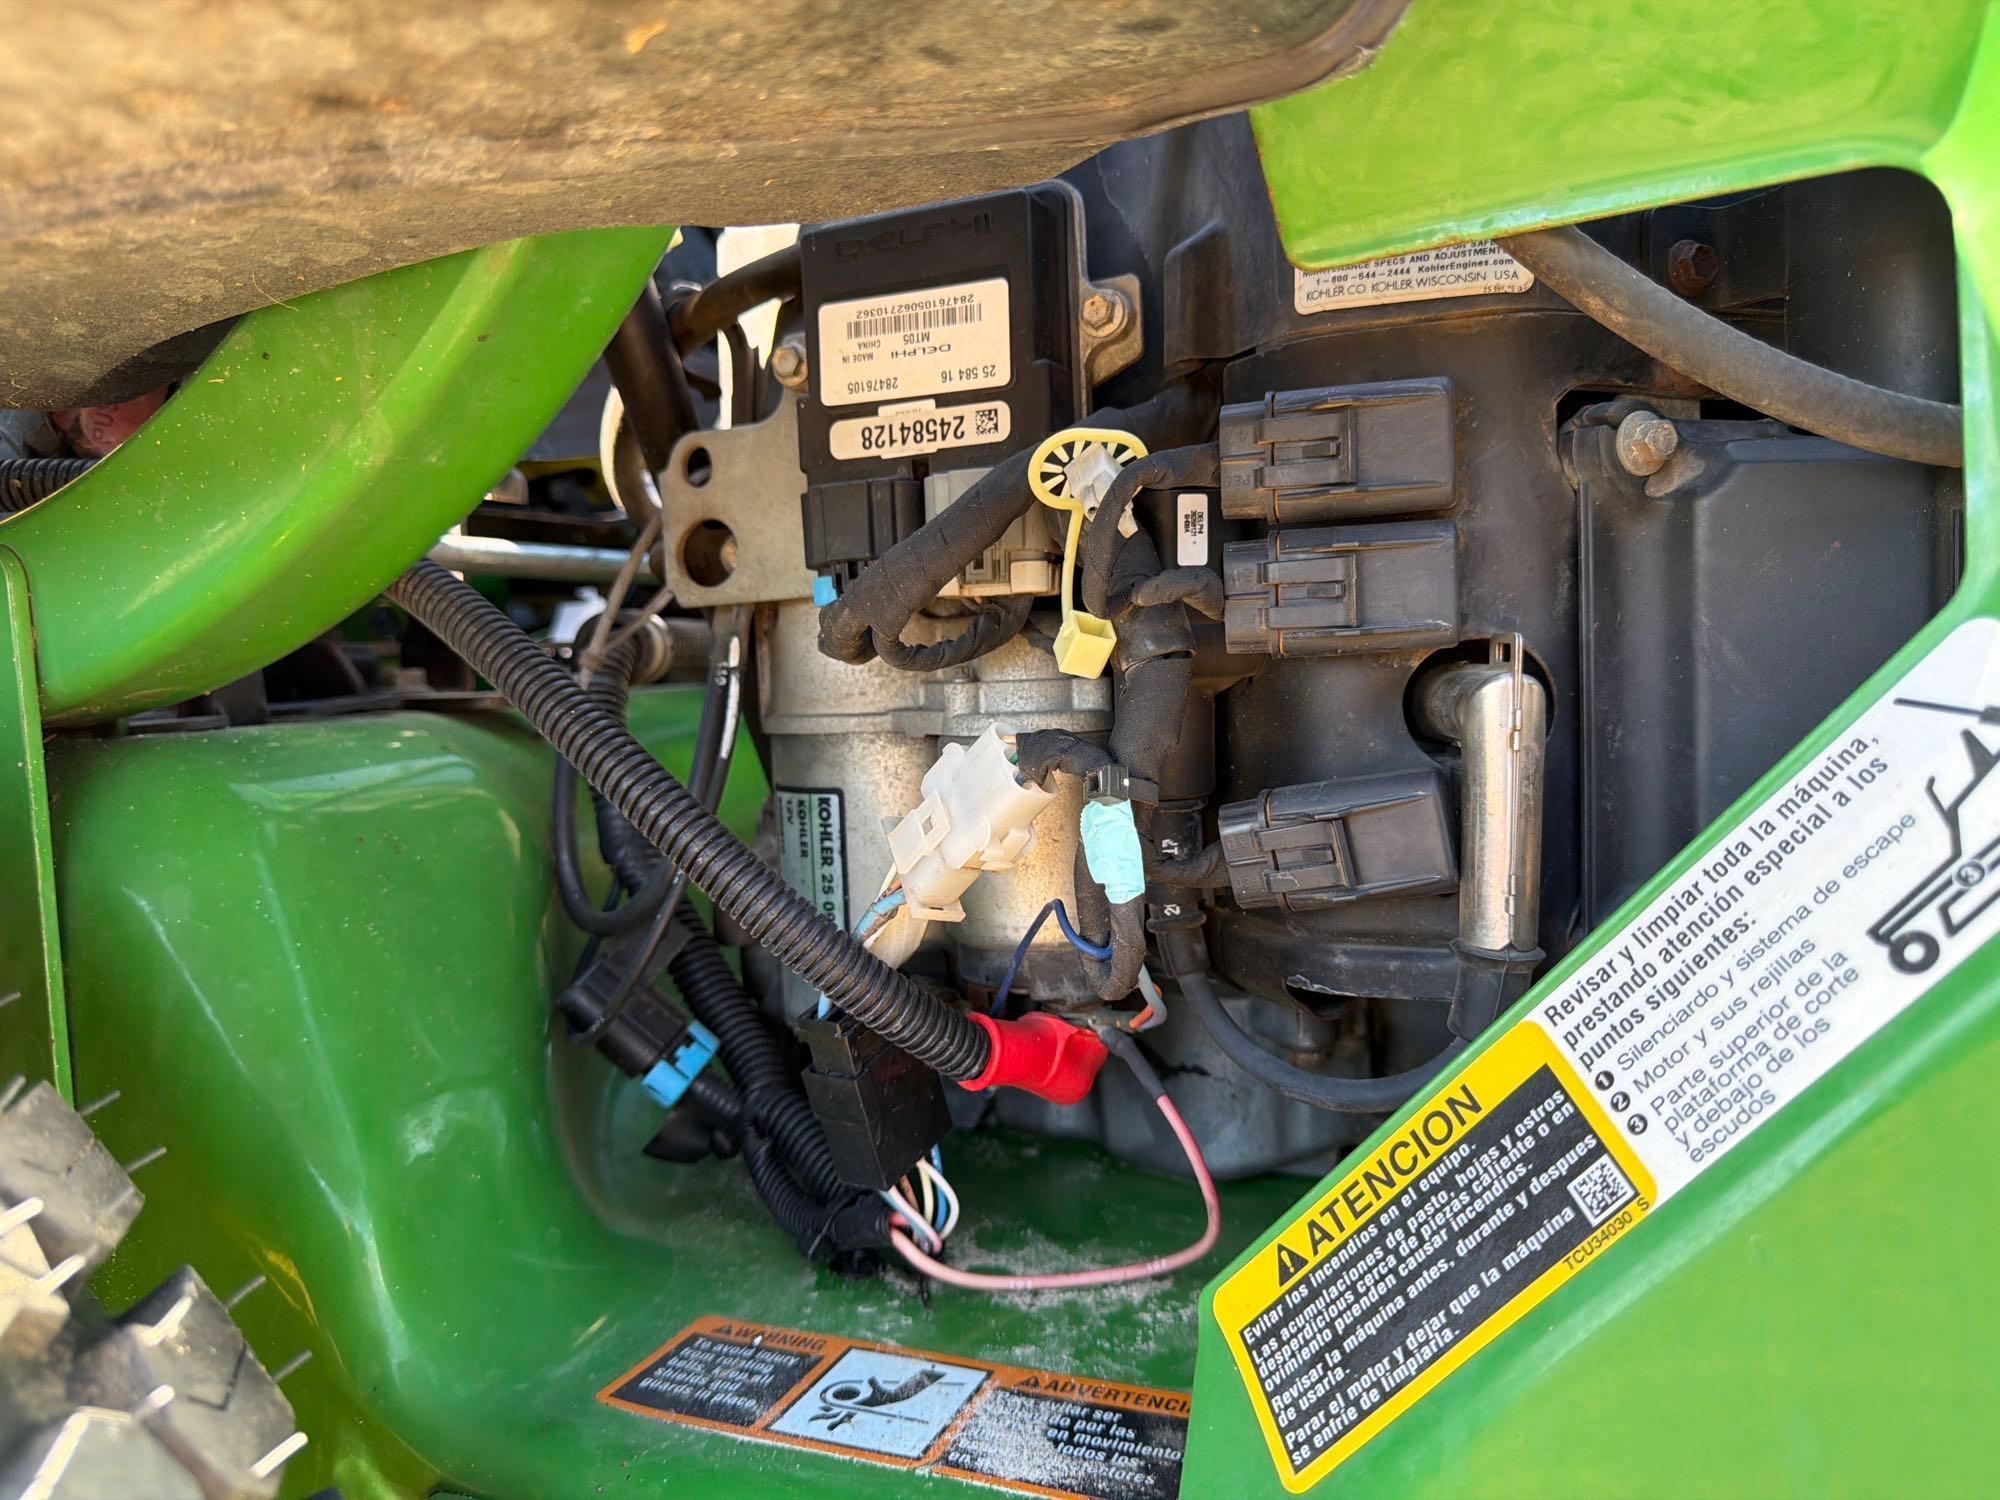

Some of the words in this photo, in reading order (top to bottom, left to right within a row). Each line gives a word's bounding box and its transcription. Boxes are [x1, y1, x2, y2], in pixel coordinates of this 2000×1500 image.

[1374, 257, 1406, 268] SPECS
[1409, 254, 1430, 264] AND
[1434, 246, 1503, 261] ADJUSTMENT
[1418, 258, 1514, 274] KohlerEngines.com
[1306, 286, 1344, 302] KOHLER
[1415, 271, 1487, 288] WISCONSIN
[1494, 270, 1519, 281] USA
[856, 294, 973, 319] 28476105062710362
[857, 339, 881, 350] CHINA
[890, 343, 951, 358] DELPHI
[903, 331, 930, 345] MT05
[852, 352, 873, 362] MADE
[958, 366, 978, 380] 584
[982, 364, 996, 378] 25
[847, 377, 898, 394] 28476105
[940, 370, 953, 383] 16
[861, 415, 964, 449] 24584128
[797, 799, 808, 858] KOHLER
[821, 874, 834, 895] 25
[1544, 959, 1617, 1026] Revisar
[1618, 945, 1635, 966] y
[1631, 881, 1703, 948] limpiar
[1702, 841, 1752, 883] toda
[1748, 819, 1776, 841] la
[1776, 738, 1878, 819] máquina,
[1563, 962, 1657, 1051] prestando
[1658, 885, 1743, 963] atención
[1744, 804, 1832, 885] especial
[1832, 791, 1851, 807] a
[1846, 758, 1888, 790] los
[1617, 984, 1718, 1070] Silenciardo
[1720, 969, 1734, 988] y
[1736, 905, 1812, 971] sistema
[1813, 880, 1840, 904] de
[1842, 814, 1915, 878] escape
[1579, 1008, 1644, 1072] puntos
[1646, 912, 1755, 1010] siguientes:
[1632, 1042, 1689, 1093] Motor
[1692, 1028, 1707, 1048] y
[1710, 996, 1747, 1030] sus
[1749, 939, 1815, 996] rejillas
[1650, 1069, 1706, 1116] Parte
[1709, 996, 1789, 1069] superior
[1794, 972, 1823, 997] de
[1821, 952, 1848, 971] la
[1664, 1041, 1771, 1134] plataforma
[1773, 1015, 1801, 1040] de
[1804, 968, 1858, 1014] corte
[1675, 1131, 1690, 1151] y
[1693, 1073, 1762, 1132] debajo
[1766, 1048, 1794, 1073] de
[1793, 1018, 1830, 1048] los
[1690, 1090, 1775, 1162] escudos
[1308, 1086, 1480, 1254] ATENCION
[1252, 1337, 1278, 1364] Las
[1280, 1247, 1383, 1340] acumulaciones
[1385, 1228, 1405, 1249] de
[1407, 1190, 1455, 1232] pasto,
[1455, 1146, 1499, 1187] hojas
[1500, 1134, 1512, 1151] y
[1514, 1090, 1564, 1136] ostros
[1259, 1291, 1354, 1377] desperdicious
[1356, 1254, 1396, 1293] cerca
[1398, 1235, 1418, 1256] de
[1420, 1191, 1470, 1240] piezas
[1472, 1136, 1535, 1193] caliente
[1537, 1123, 1549, 1136] o
[1552, 1102, 1574, 1124] en
[1563, 1211, 1632, 1269] TCU34030
[1636, 1196, 1650, 1211] S
[1243, 1304, 1283, 1344] Evitar
[1284, 1284, 1308, 1308] los
[1309, 1224, 1377, 1286] incendios
[1379, 1205, 1399, 1226] en
[1401, 1186, 1417, 1207] el
[1419, 1144, 1475, 1191] equipo.
[1264, 1329, 1332, 1391] ovimiento
[1334, 1274, 1396, 1334] puenden
[1398, 1228, 1447, 1276] causar
[1449, 1163, 1532, 1231] incendios.
[1271, 1363, 1323, 1413] Revisar
[1324, 1349, 1341, 1367] la
[1343, 1295, 1405, 1352] máquina
[1406, 1259, 1454, 1298] antes,
[1456, 1203, 1514, 1256] durante
[1515, 1191, 1528, 1209] y
[1529, 1134, 1596, 1194] despues
[1285, 1410, 1325, 1449] Parar
[1328, 1392, 1345, 1414] el
[1346, 1357, 1390, 1399] motor
[1392, 1346, 1404, 1364] y
[1406, 1310, 1446, 1352] dejar
[1449, 1284, 1480, 1314] que
[1480, 1267, 1500, 1287] la
[1502, 1207, 1574, 1270] máquina
[680, 1347, 715, 1362] from
[694, 1337, 712, 1350] To
[713, 1343, 757, 1358] avoid
[756, 1349, 800, 1368] injury
[639, 1377, 694, 1395] guards
[694, 1387, 712, 1400] in
[653, 1366, 710, 1387] shields
[710, 1379, 744, 1393] and
[1278, 1406, 1296, 1427] de
[1298, 1367, 1349, 1410] usarla.
[1292, 1444, 1310, 1465] se
[1359, 1388, 1380, 1410] de
[1381, 1328, 1459, 1391] limpiarla.
[1073, 1420, 1106, 1434] por
[1111, 1422, 1136, 1440] las
[1093, 1409, 1123, 1423] ser
[1047, 1428, 1070, 1440] en
[1056, 1442, 1106, 1461] todos
